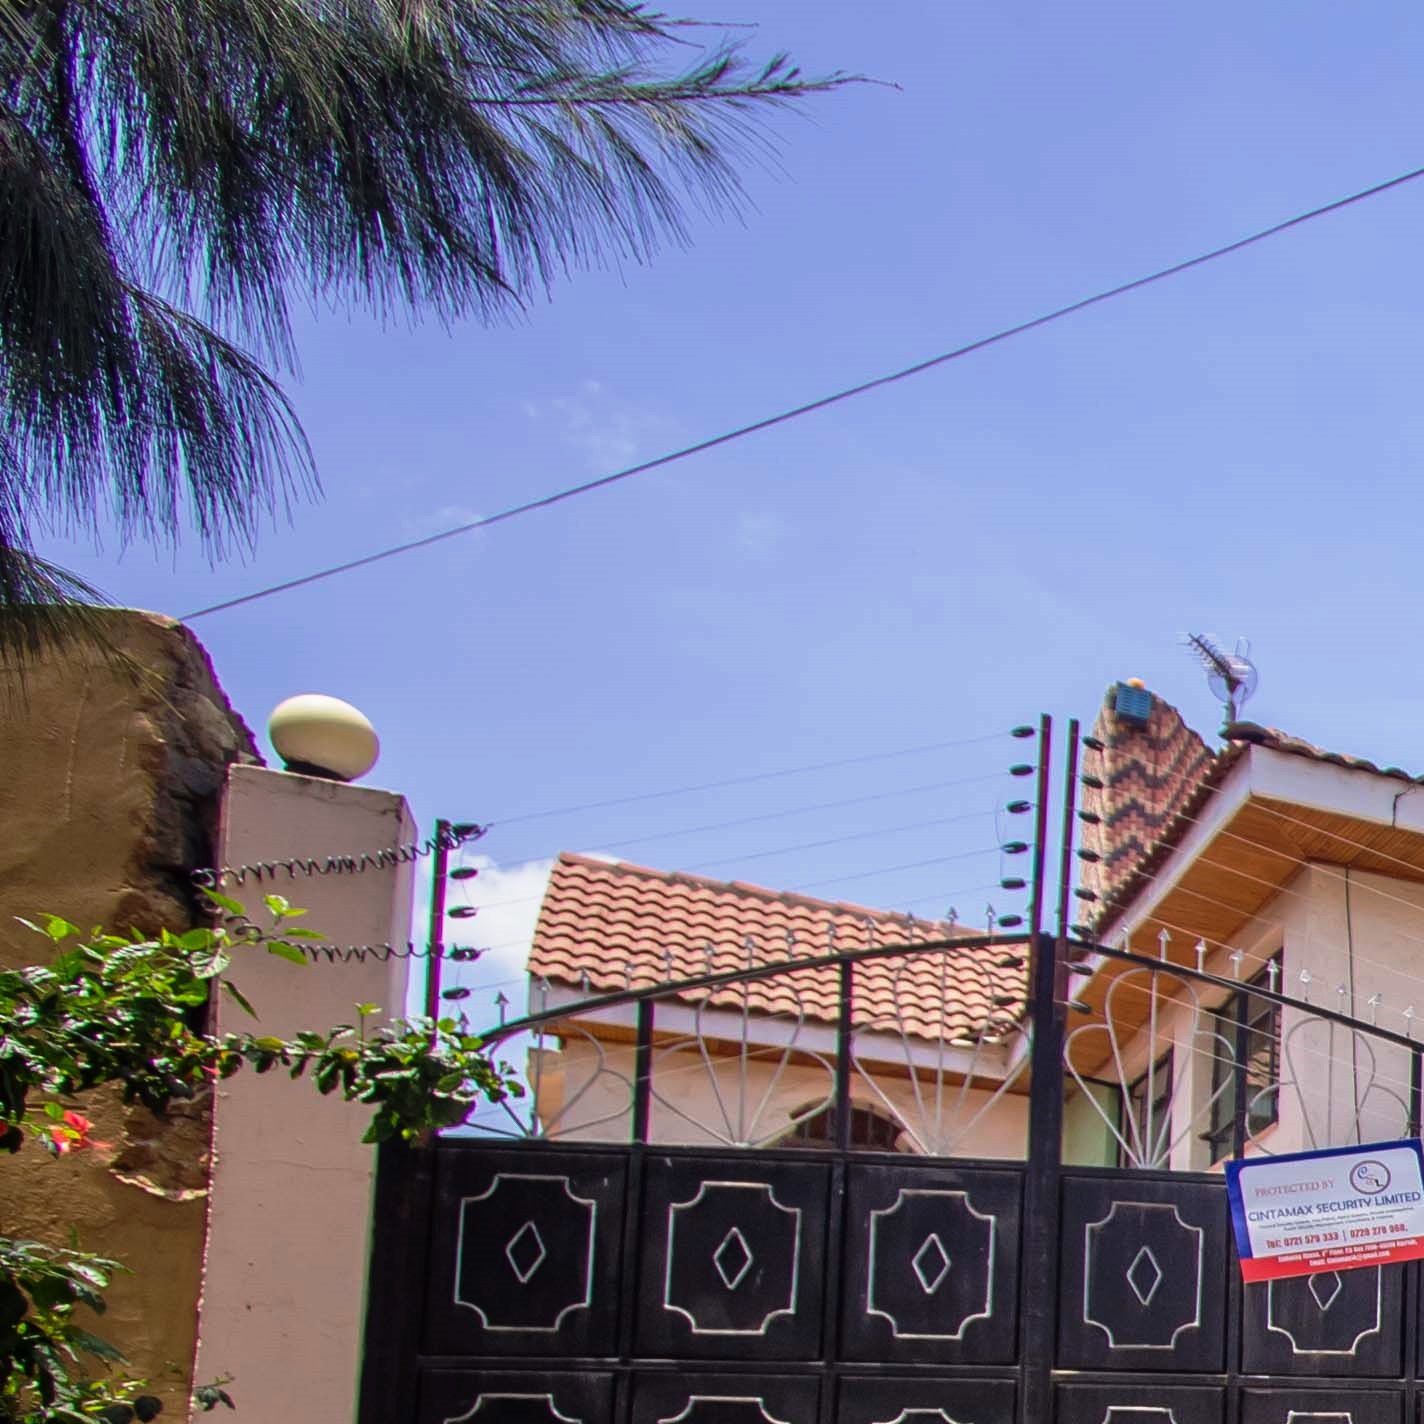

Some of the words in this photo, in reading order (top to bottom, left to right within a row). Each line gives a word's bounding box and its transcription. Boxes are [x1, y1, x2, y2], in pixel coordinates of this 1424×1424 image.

[1255, 1182, 1319, 1197] PROTECTED
[1321, 1179, 1335, 1190] BY
[1248, 1205, 1313, 1221] CINTAMAX
[1316, 1198, 1371, 1213] SECURITY
[1375, 1191, 1421, 1206] LIMITED
